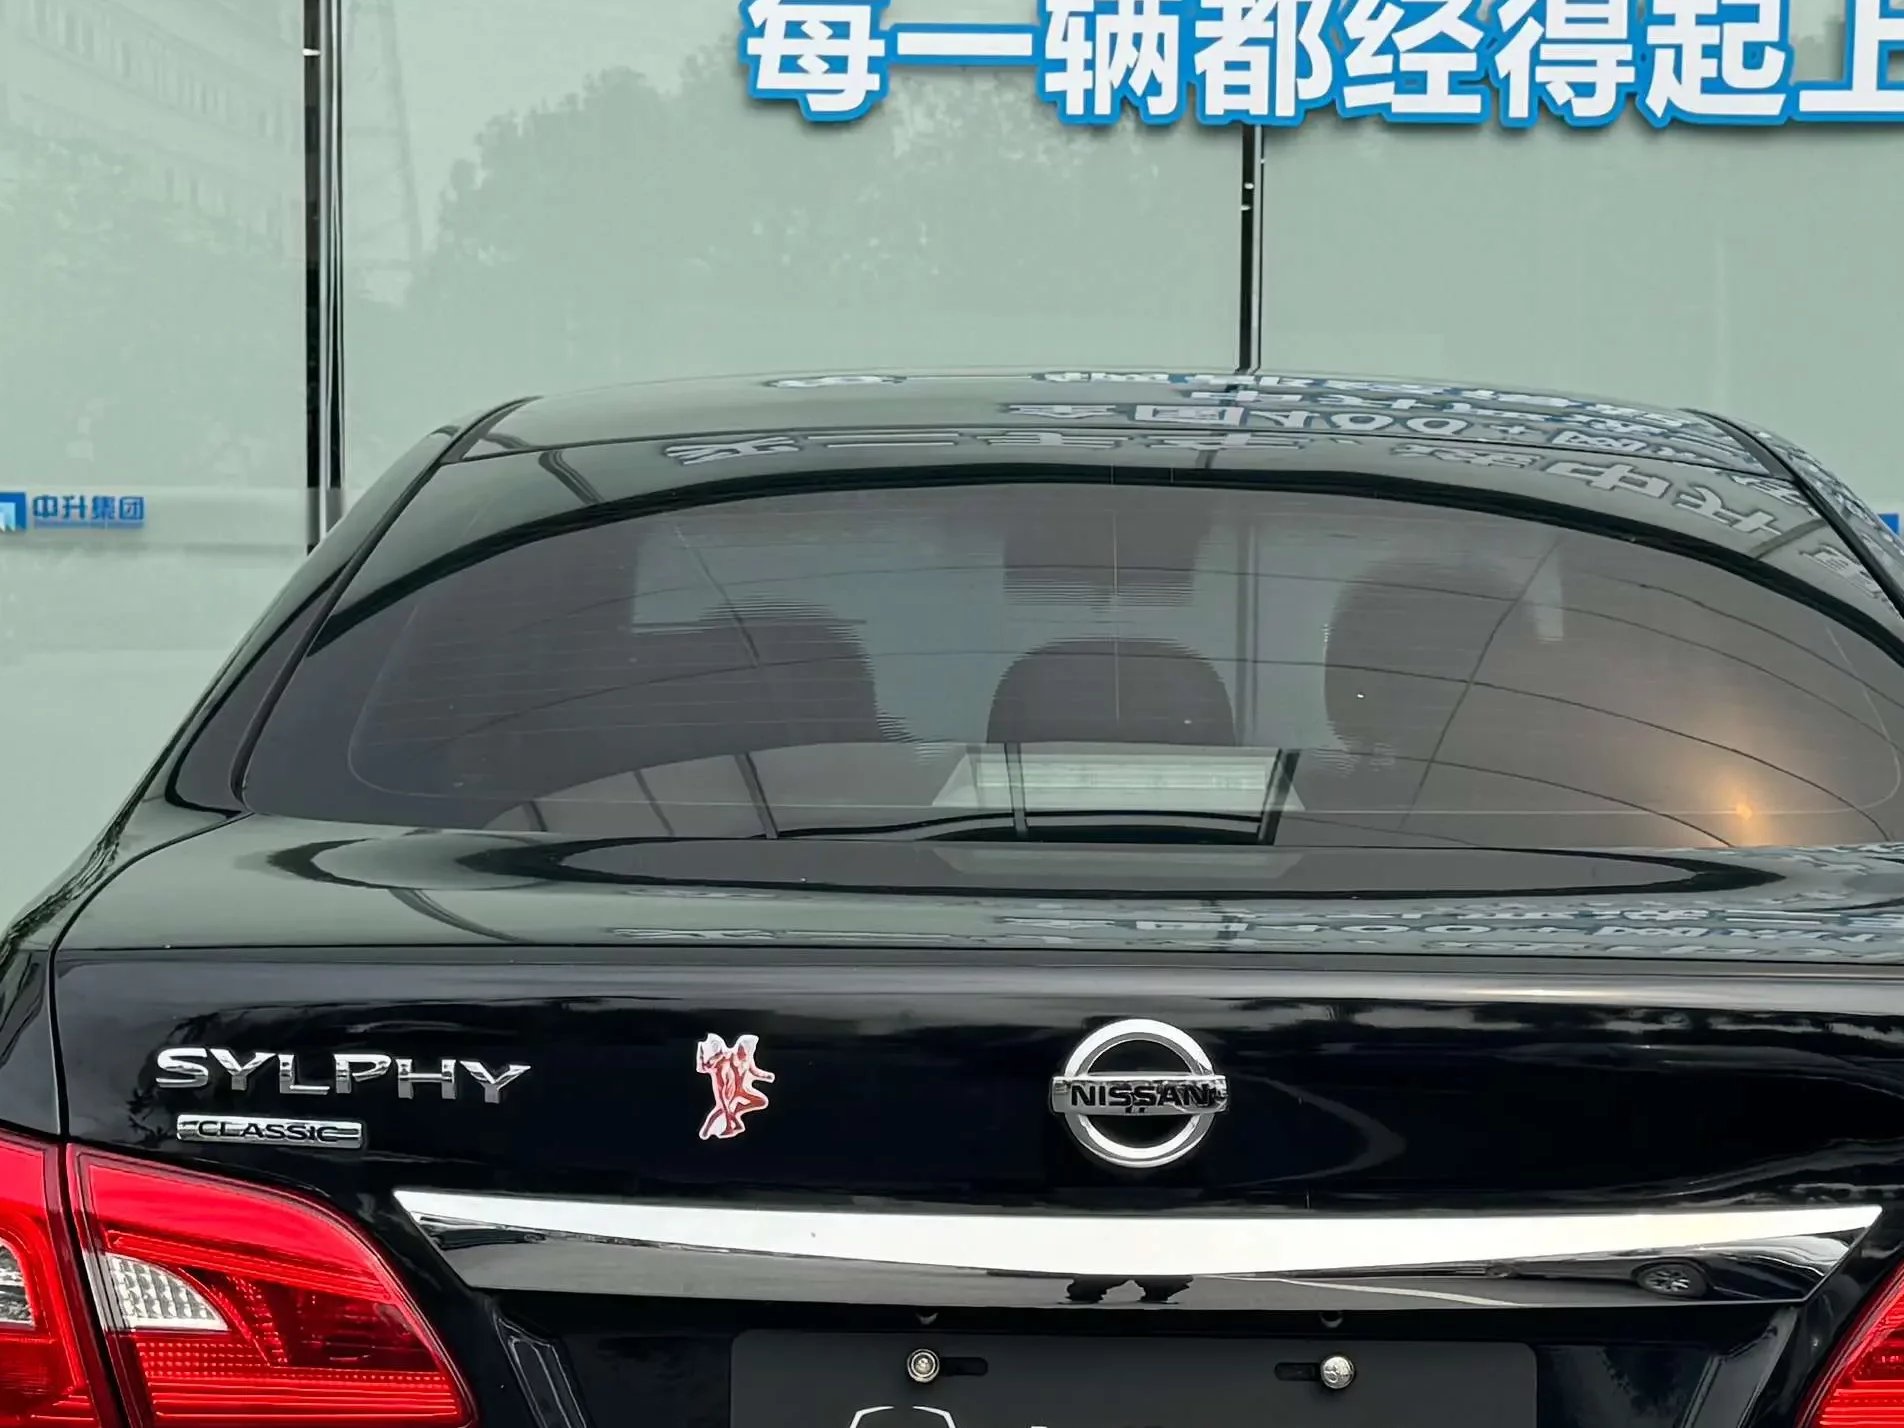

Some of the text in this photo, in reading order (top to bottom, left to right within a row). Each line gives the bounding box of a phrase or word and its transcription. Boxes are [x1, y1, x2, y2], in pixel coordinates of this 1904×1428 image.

[32, 494, 145, 520] 中升集团
[154, 1047, 532, 1103] SYLPHY
[1070, 1084, 1210, 1107] NISSAN
[196, 1119, 339, 1143] CLASSIC
